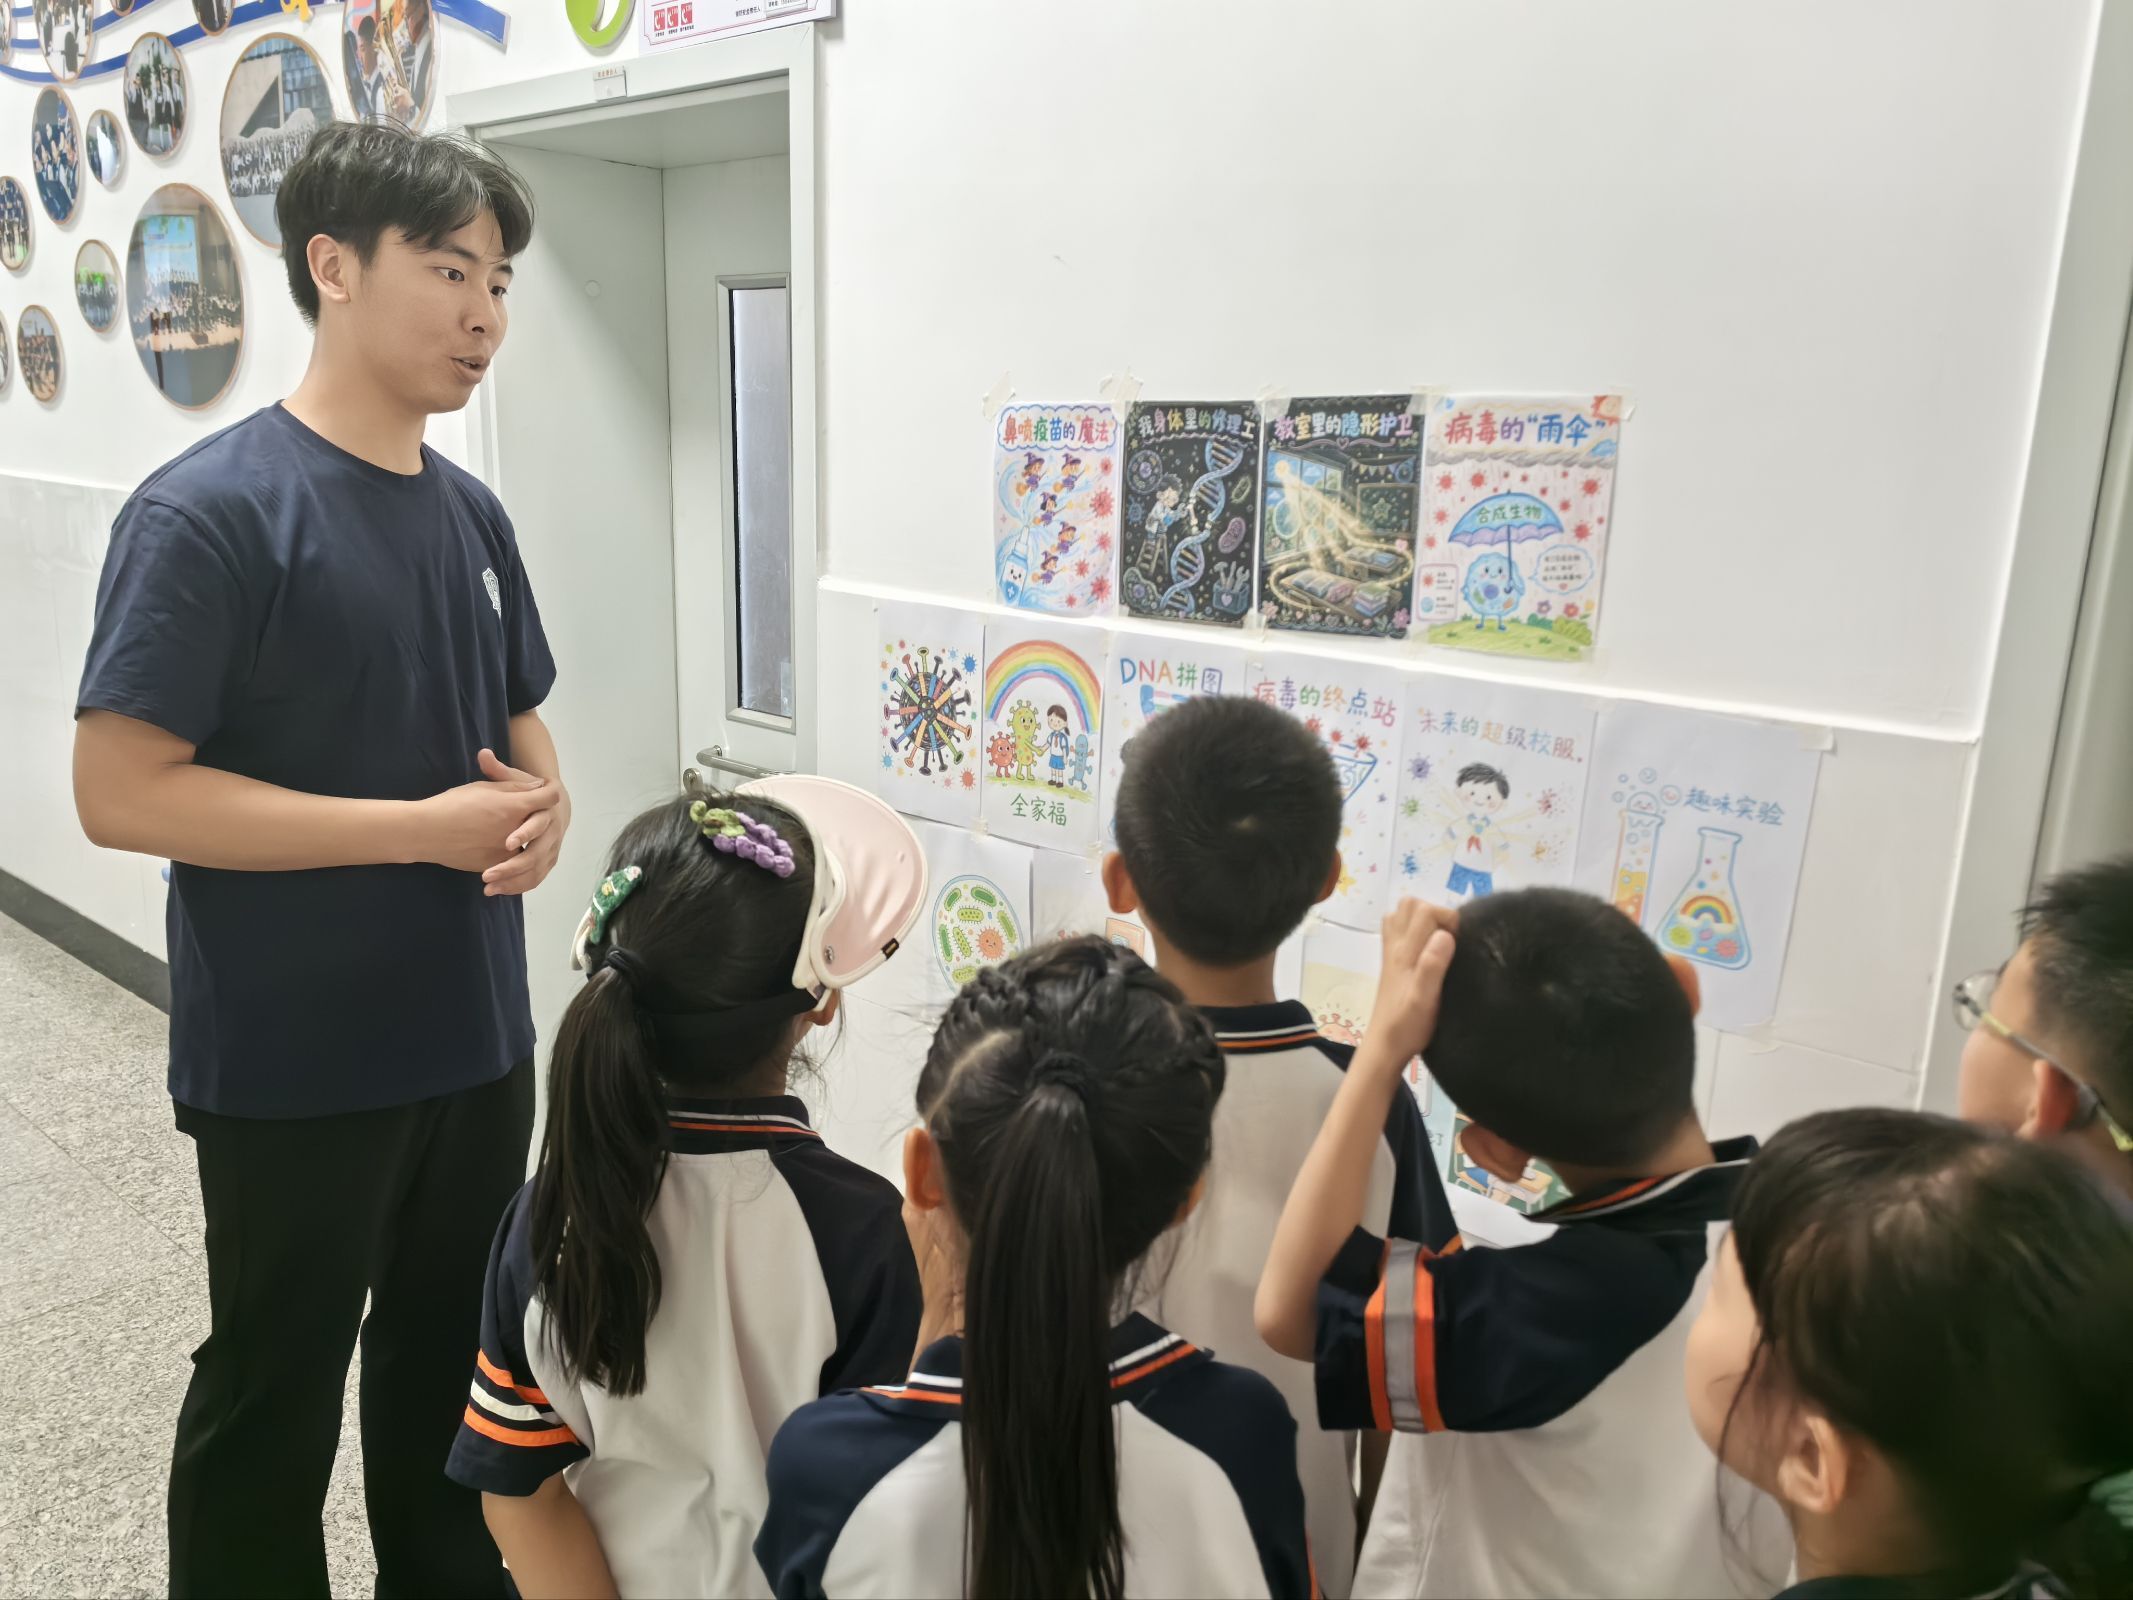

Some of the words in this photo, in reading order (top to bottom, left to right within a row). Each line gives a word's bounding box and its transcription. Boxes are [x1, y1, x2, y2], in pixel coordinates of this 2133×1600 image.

[1003, 414, 1110, 445] 鼻喷疫苗的魔法
[1138, 407, 1256, 439] 我身体里的修理工
[1274, 410, 1414, 440] 教室里的隐形护卫
[1477, 503, 1542, 524] 合成生物
[1120, 657, 1224, 695] DNA拼图
[1253, 676, 1397, 727] 病毒的终点站
[1010, 793, 1067, 827] 全家福
[1683, 786, 1785, 826] 趣味实验
